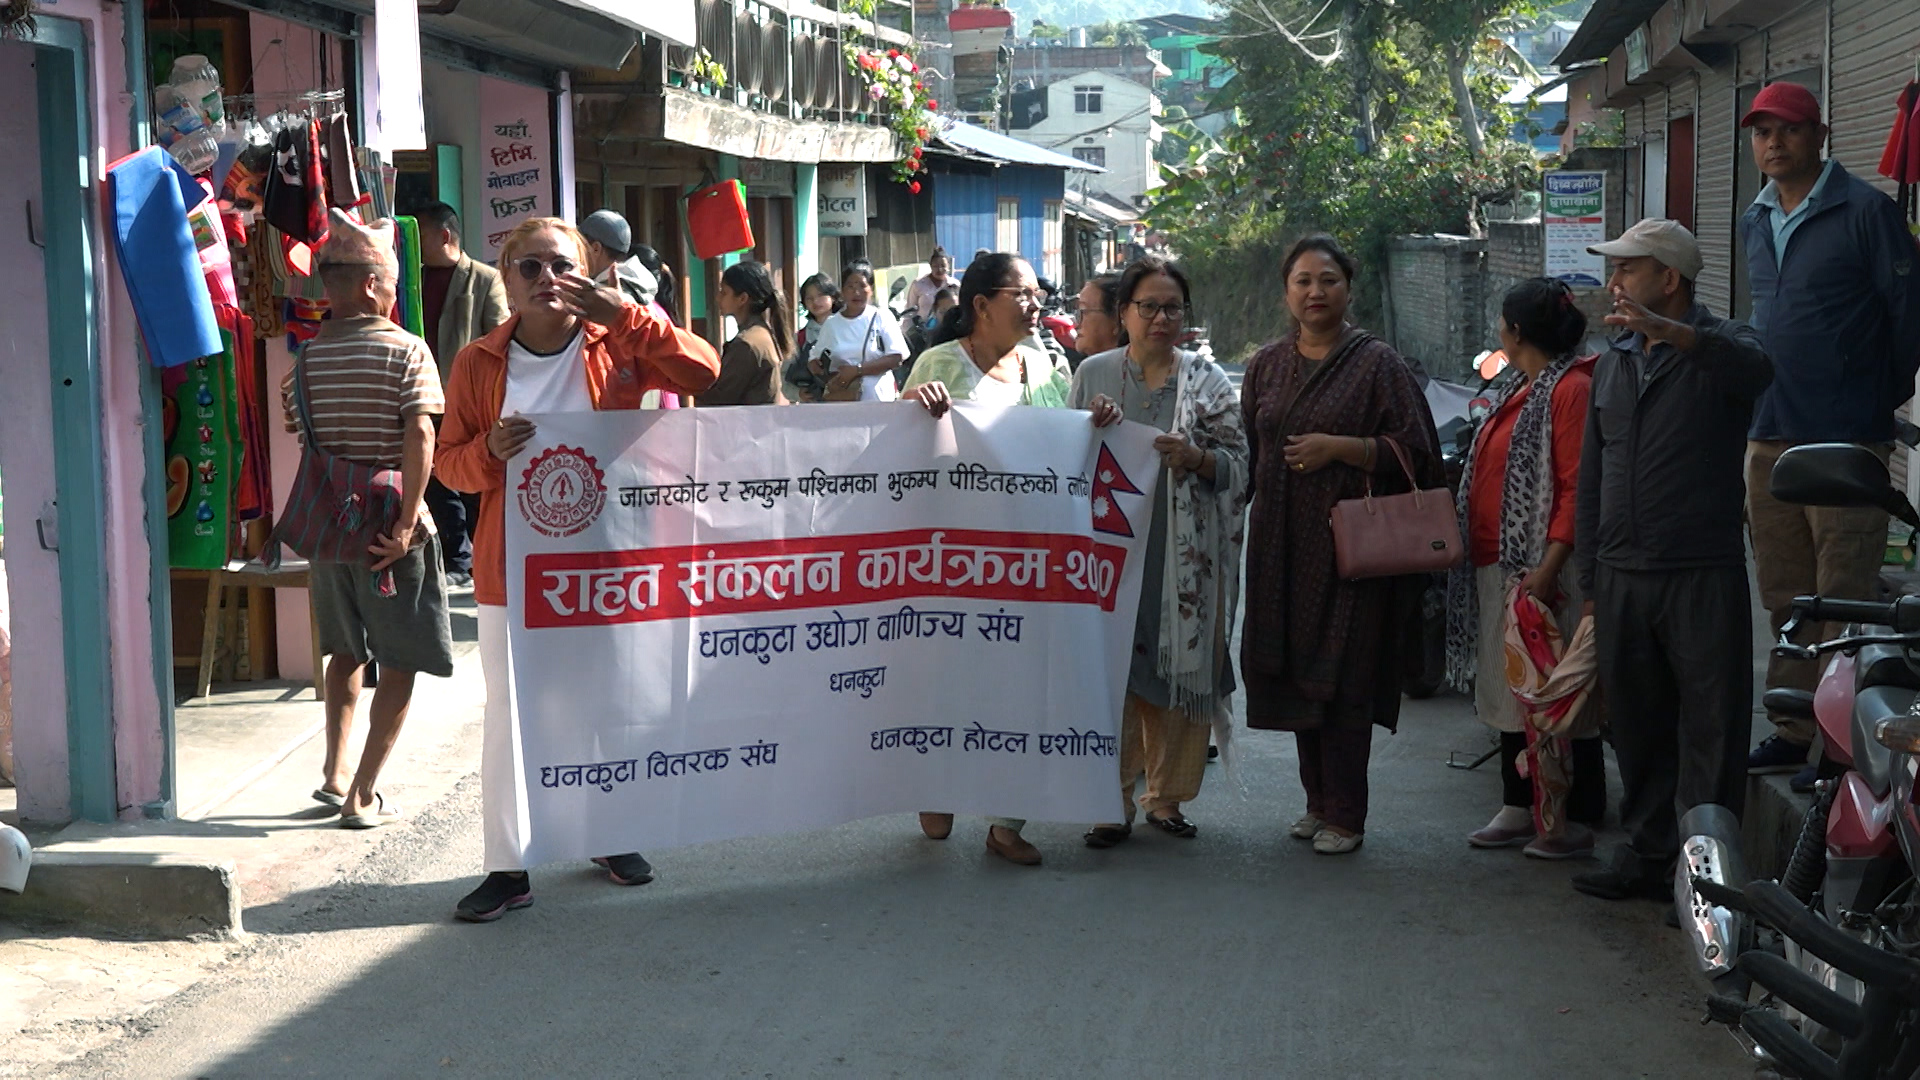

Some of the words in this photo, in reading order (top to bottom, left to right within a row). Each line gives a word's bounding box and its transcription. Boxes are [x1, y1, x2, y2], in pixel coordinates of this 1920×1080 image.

[490, 195, 537, 219] फ्रिज
[618, 475, 710, 507] जाजरकोट
[718, 481, 731, 502] र
[797, 467, 879, 498] पश्चिमका
[887, 469, 940, 501] भुकम्प
[541, 563, 664, 617] राहत
[677, 550, 845, 607] संकलन
[699, 624, 798, 664] धनकुटा
[805, 609, 870, 651] उद्योग
[877, 605, 967, 642] वाणिज्य
[976, 608, 1024, 643] संघ
[829, 666, 887, 699] धनकुटा
[870, 725, 954, 754] धनकुटा
[963, 721, 1030, 754] होटल
[540, 759, 639, 793] धनकुटा
[646, 747, 732, 781] वितरक
[739, 739, 779, 768] संघ
